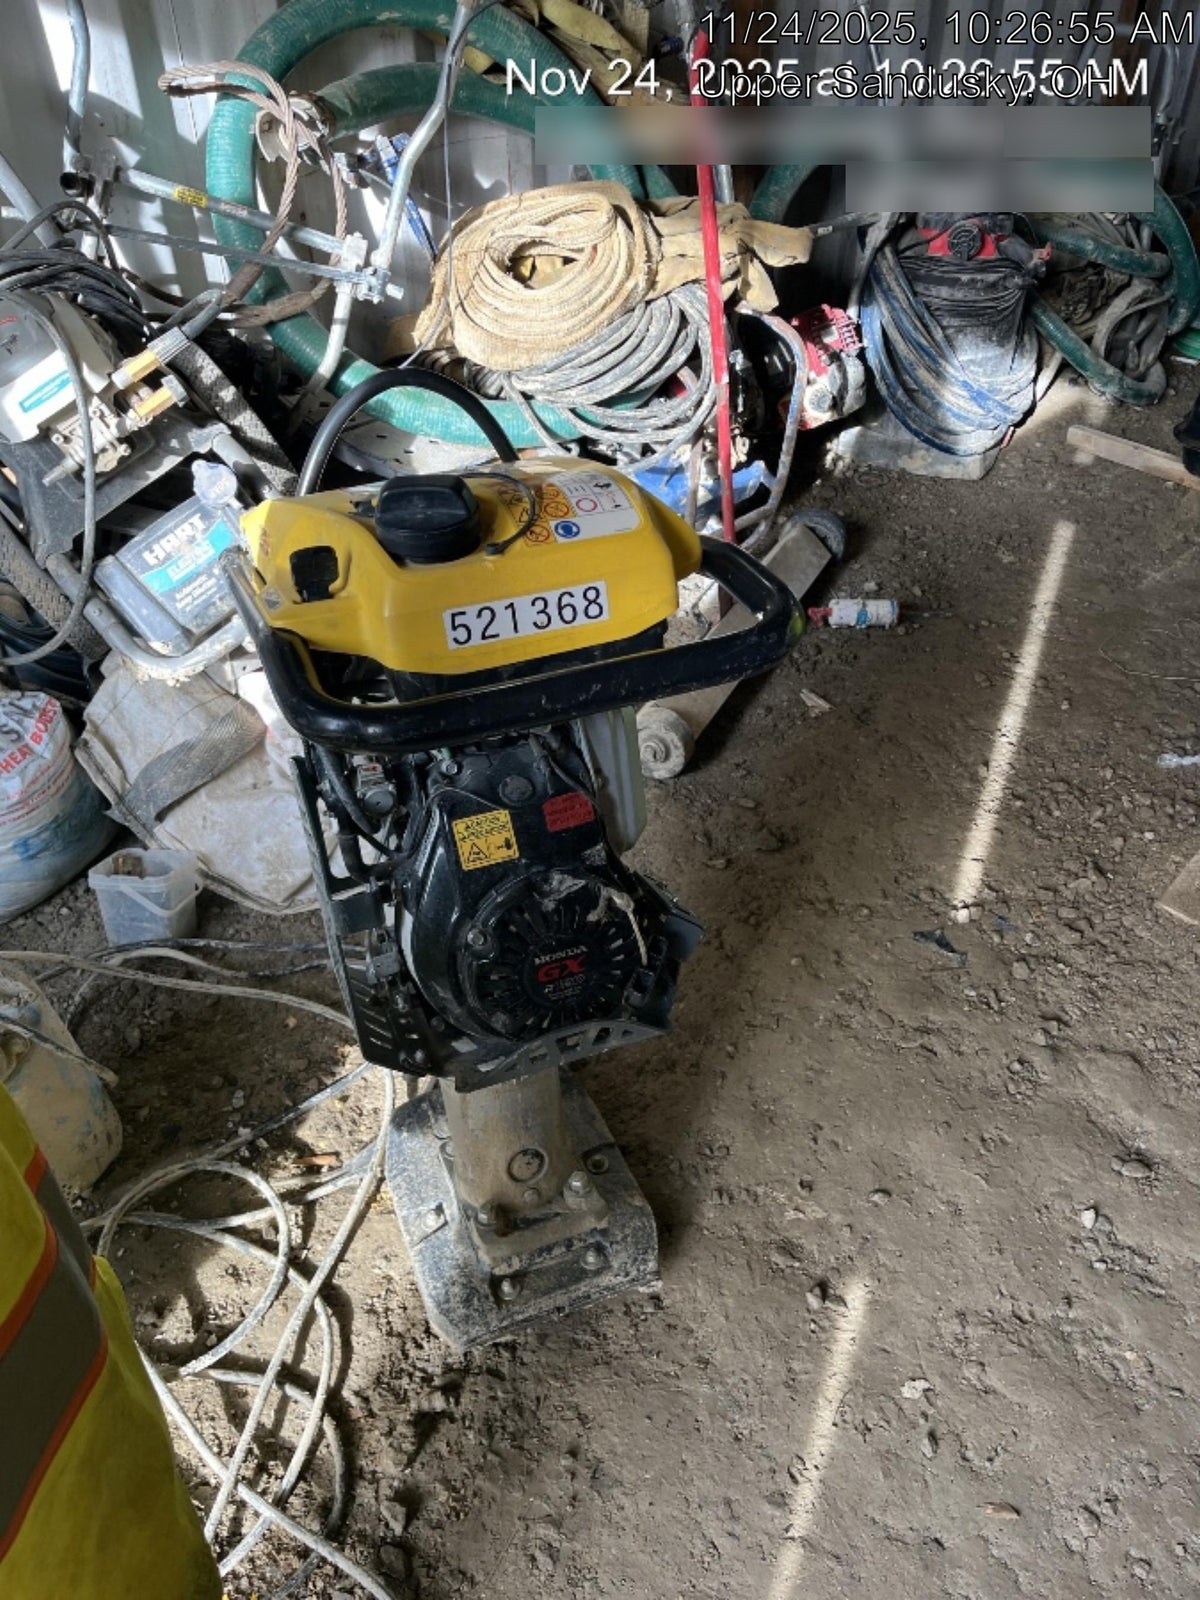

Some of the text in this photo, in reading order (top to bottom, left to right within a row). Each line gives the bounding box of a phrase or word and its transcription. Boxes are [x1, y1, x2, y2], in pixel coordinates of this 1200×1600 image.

[142, 513, 207, 567] HART
[450, 586, 604, 646] 521368
[533, 945, 588, 965] HONDA
[536, 954, 588, 983] GX
